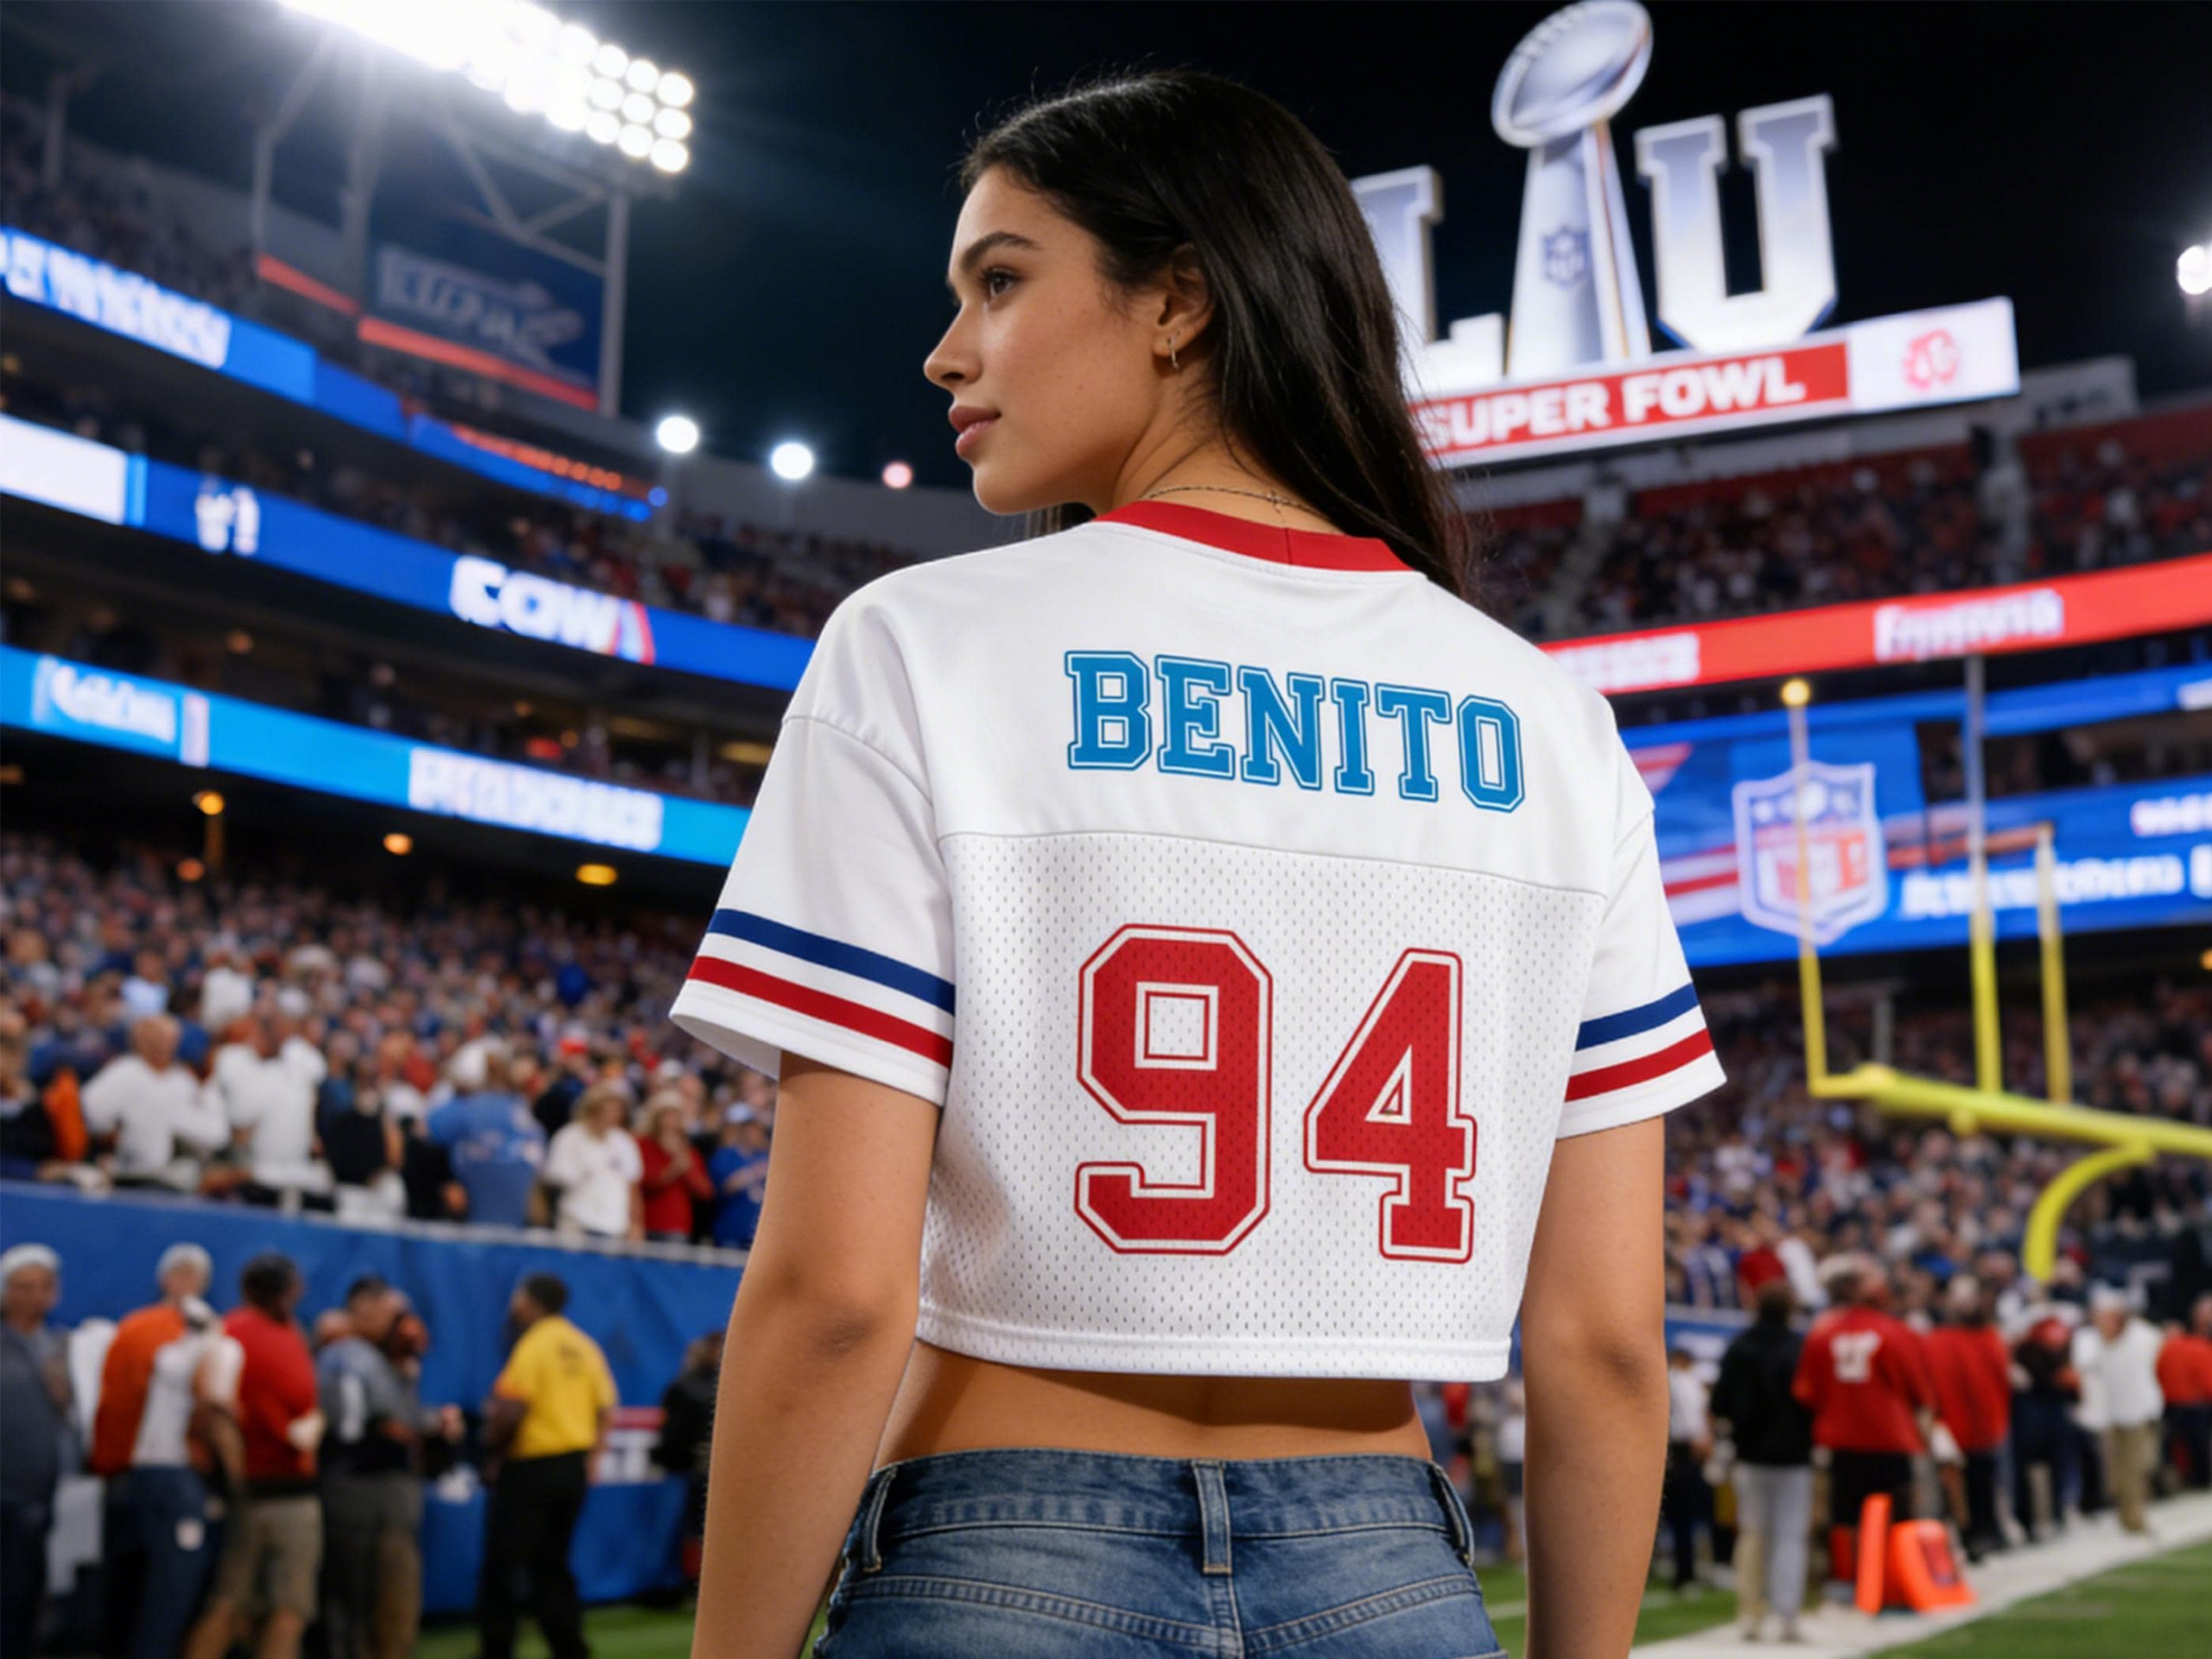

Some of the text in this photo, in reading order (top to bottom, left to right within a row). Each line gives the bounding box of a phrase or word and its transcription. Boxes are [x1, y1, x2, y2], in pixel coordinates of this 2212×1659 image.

[1419, 355, 1808, 448] SUPER FOWL
[1064, 650, 1527, 813] BENITO
[1074, 924, 1478, 1264] 94
